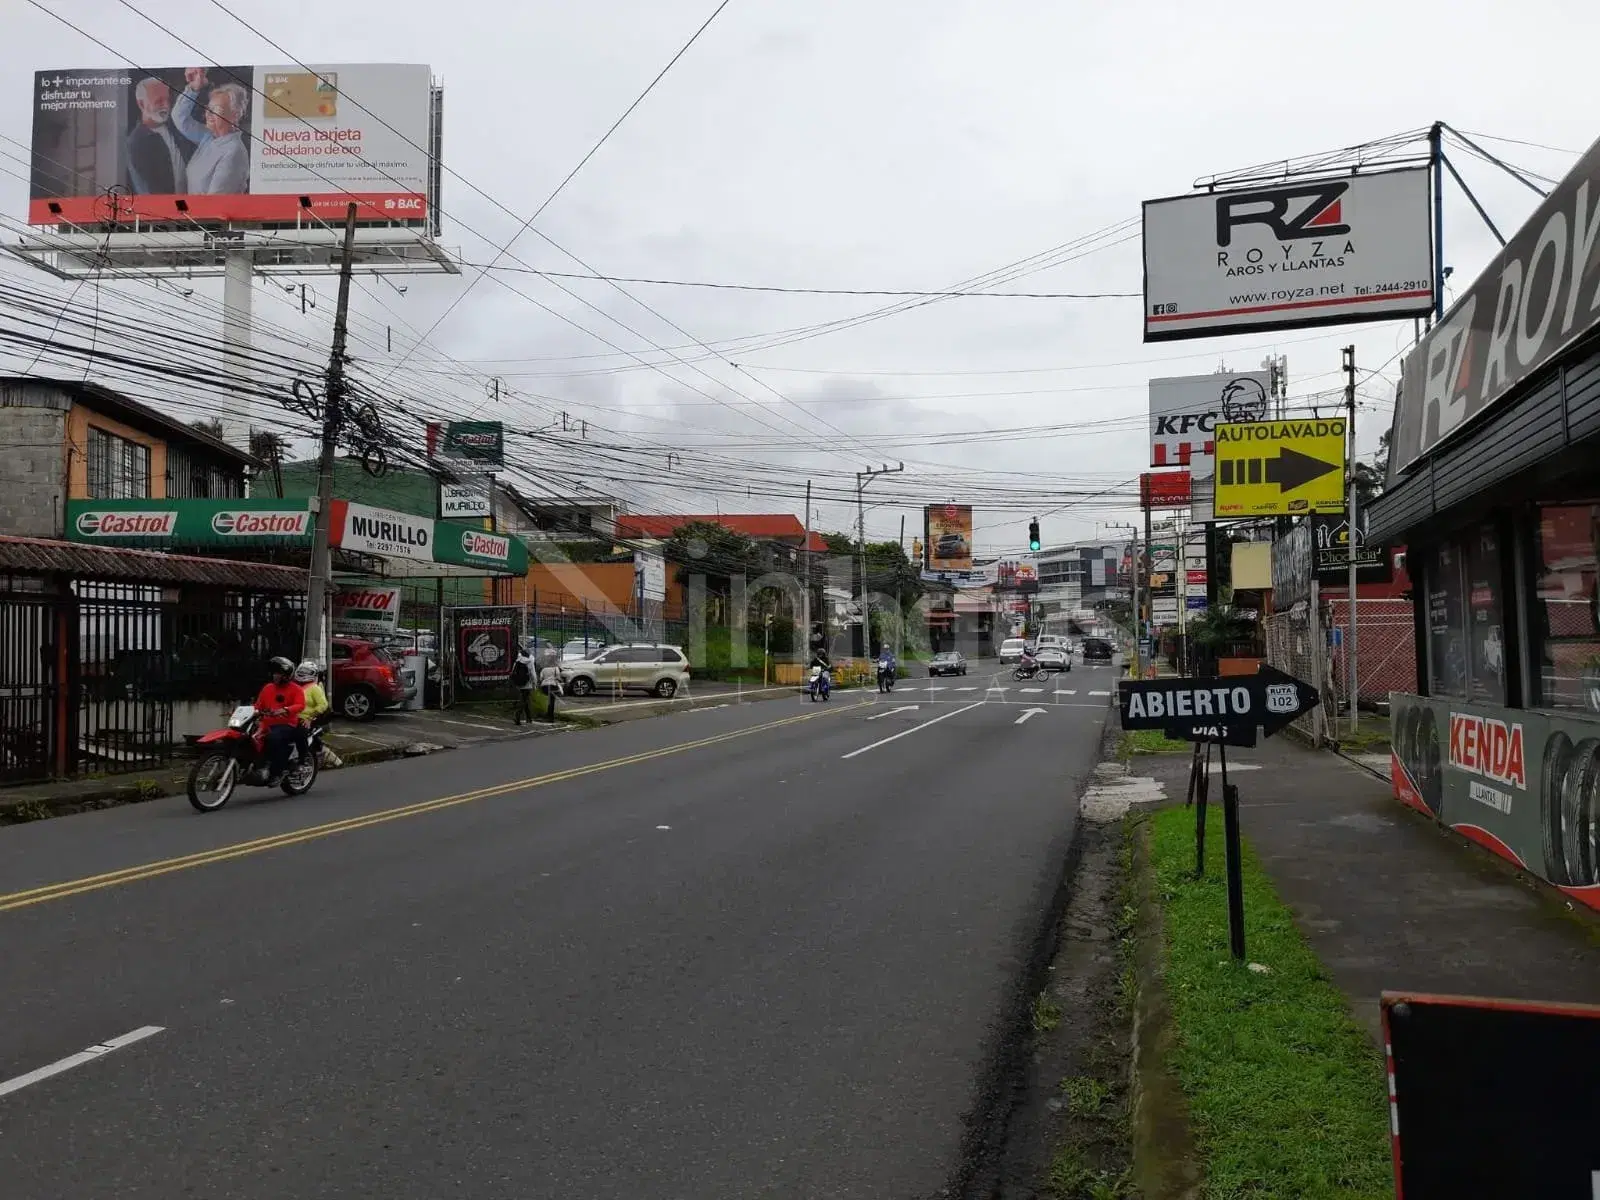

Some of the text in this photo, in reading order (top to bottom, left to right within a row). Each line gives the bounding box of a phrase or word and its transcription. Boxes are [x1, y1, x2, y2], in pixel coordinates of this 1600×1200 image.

[66, 76, 118, 88] importante
[119, 77, 132, 85] es
[40, 100, 117, 111] mejor momento
[41, 90, 91, 101] disfrutar tu
[263, 127, 361, 143] Nueva tarjeta
[262, 143, 361, 156] ciudadano de oro
[398, 199, 421, 209] BAC
[1216, 181, 1351, 247] RZ
[1217, 240, 1355, 267] ROYZA
[1226, 257, 1345, 278] AROS Y LLANTAS
[1229, 282, 1345, 305] www.royza.net
[1480, 178, 1600, 400] ROY
[1154, 411, 1218, 435] KFC
[1217, 421, 1345, 443] AUTOLAVADO
[101, 513, 170, 533] Castrol
[236, 513, 304, 532] Castrol
[352, 516, 428, 547] MURILLO
[473, 535, 507, 557] Castrol
[460, 617, 512, 626] CAMBIO DE ACEITE
[1270, 687, 1292, 695] RUTA
[1128, 686, 1251, 719] ABIERTO
[1272, 696, 1292, 707] 102
[1449, 712, 1526, 790] KENDA
[1475, 785, 1496, 805] LLANTAS
